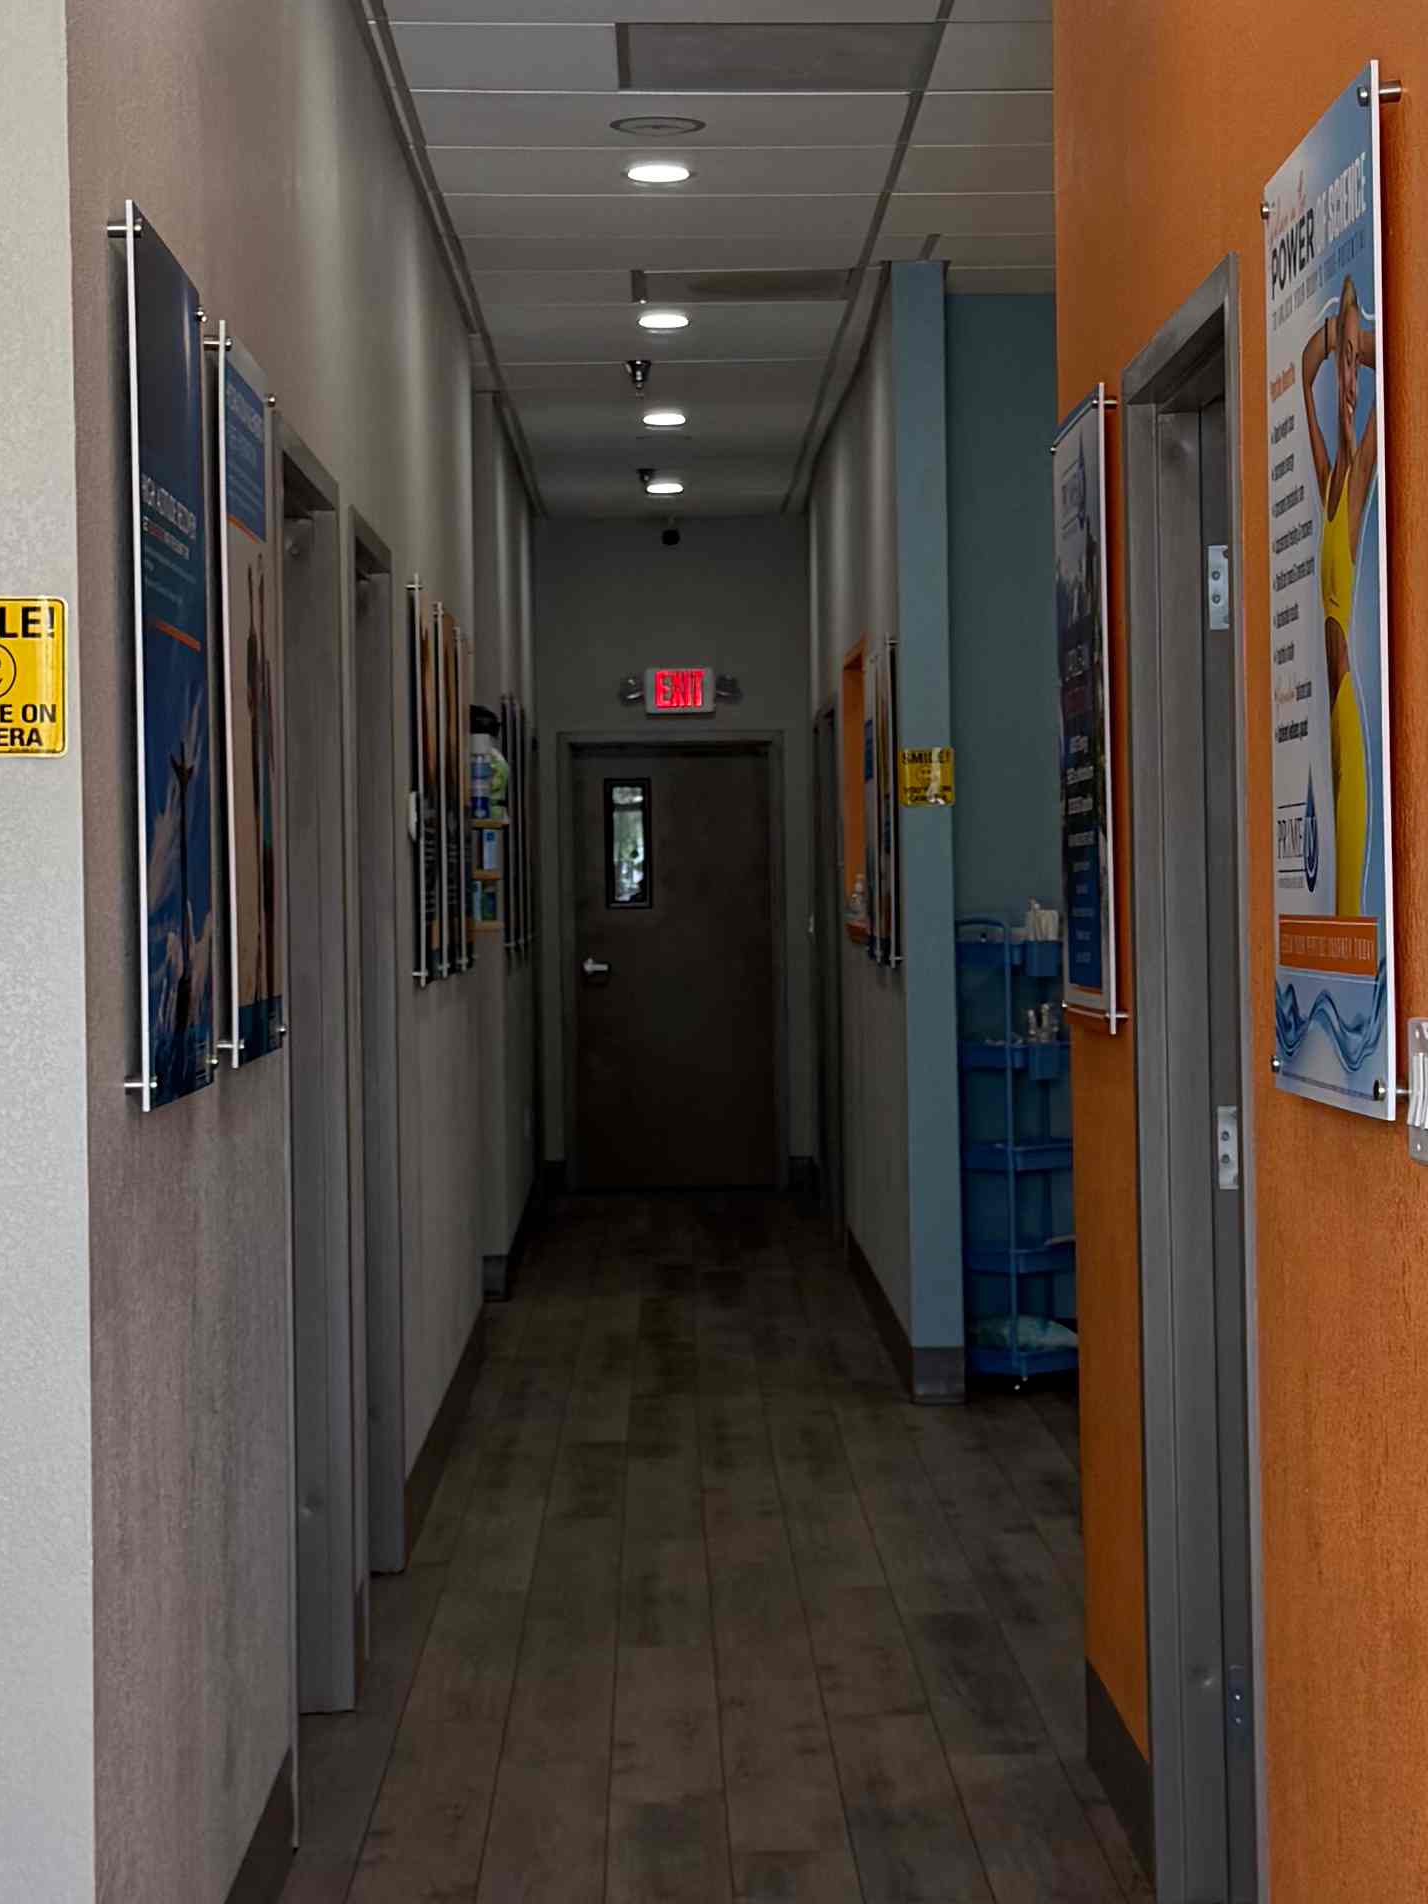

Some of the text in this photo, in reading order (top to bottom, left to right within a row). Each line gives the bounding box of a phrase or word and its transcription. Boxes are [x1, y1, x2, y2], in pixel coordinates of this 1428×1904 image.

[1272, 207, 1314, 301] POWER
[655, 670, 704, 708] EXIT
[21, 703, 56, 723] ON
